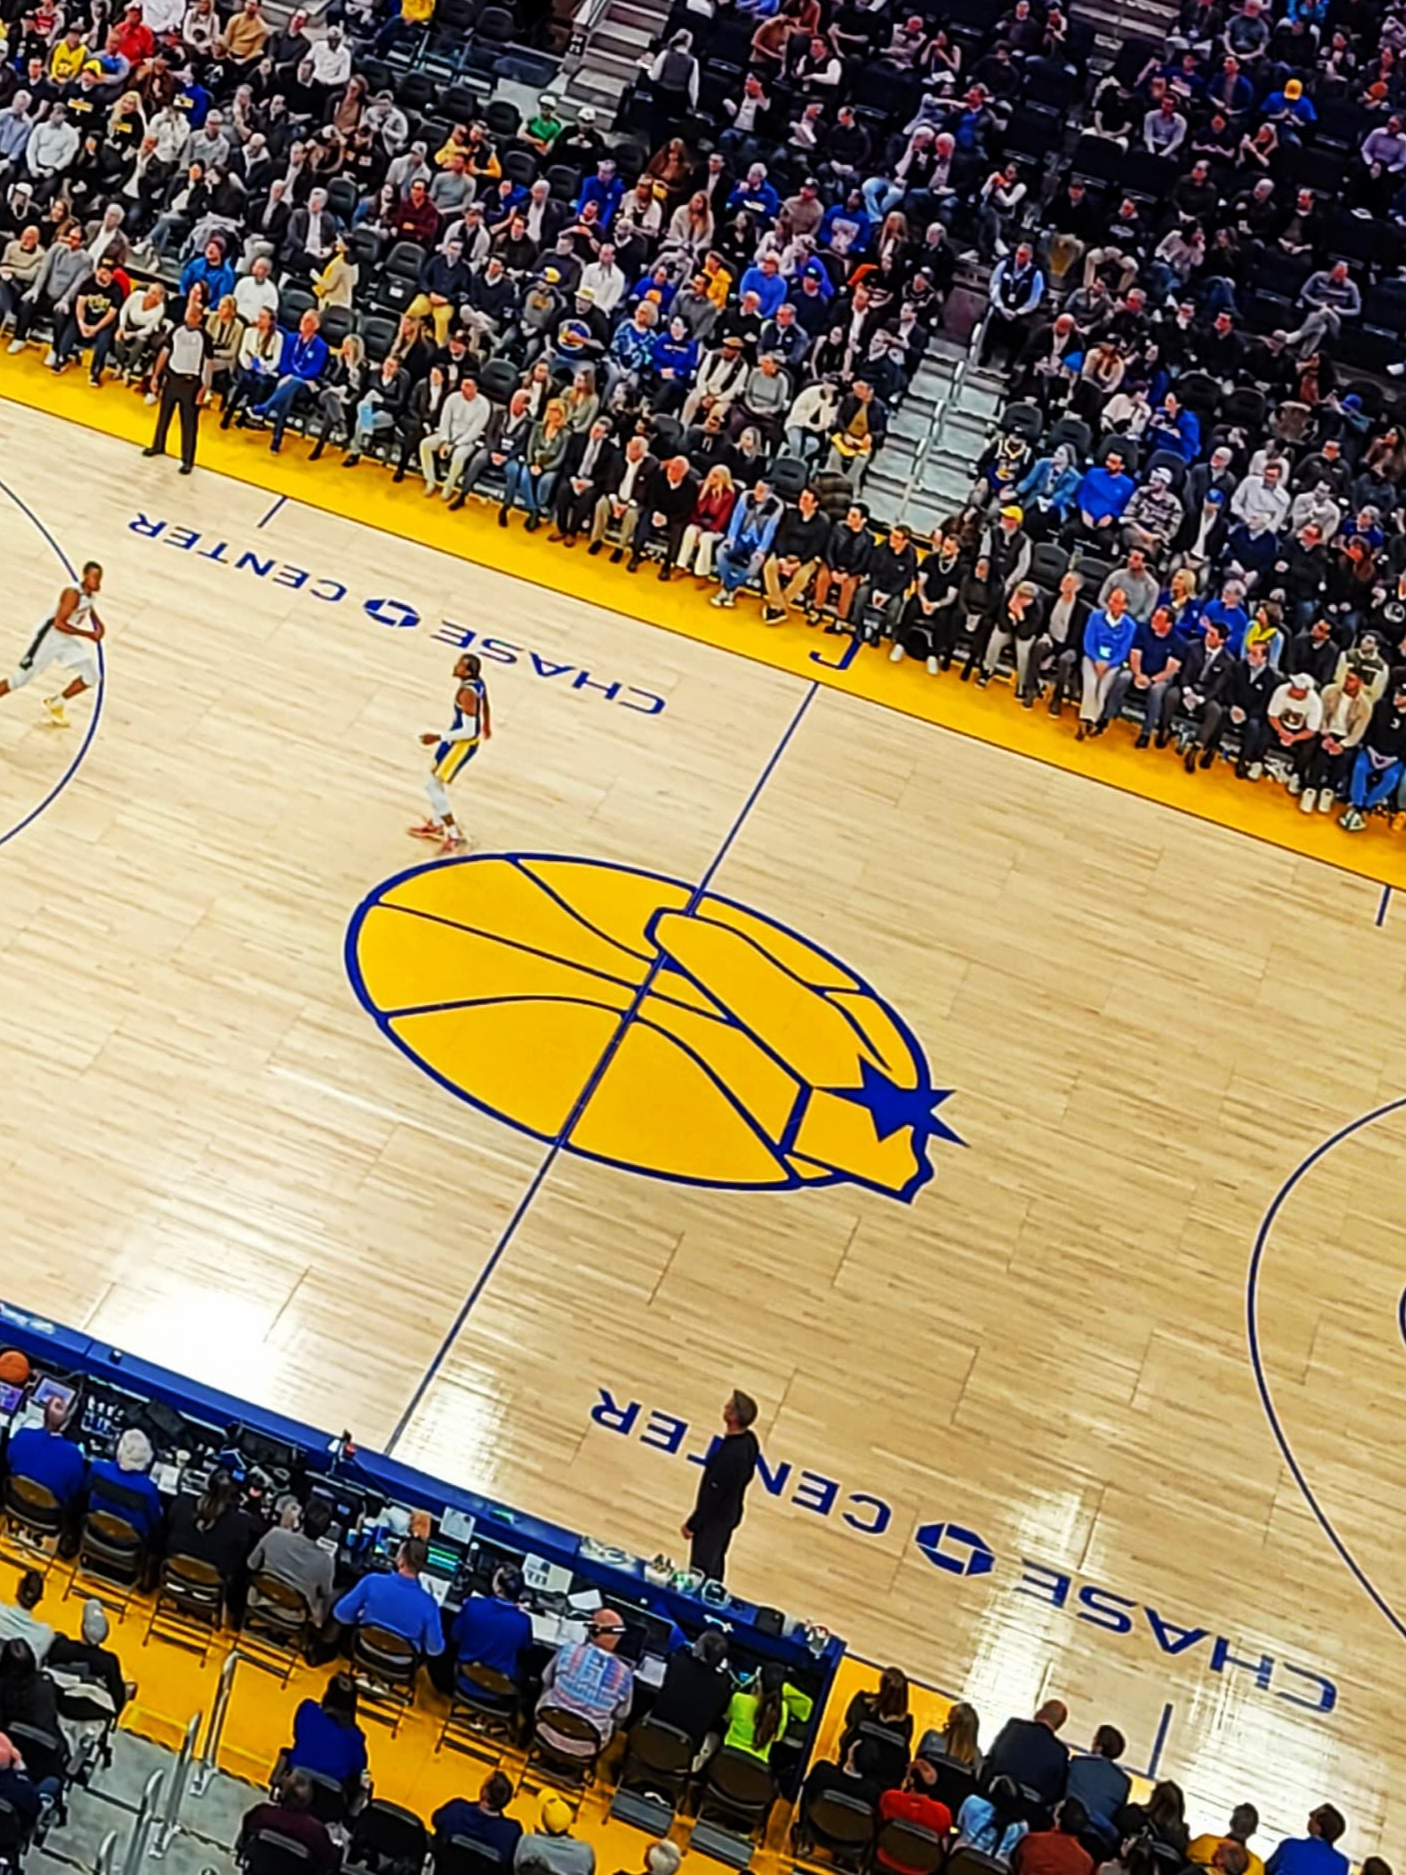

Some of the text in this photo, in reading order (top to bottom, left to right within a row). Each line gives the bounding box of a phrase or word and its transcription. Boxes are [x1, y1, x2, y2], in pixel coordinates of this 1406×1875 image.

[127, 512, 667, 716] CHASE CENTER
[591, 1388, 1338, 1715] CHASE CENTER
